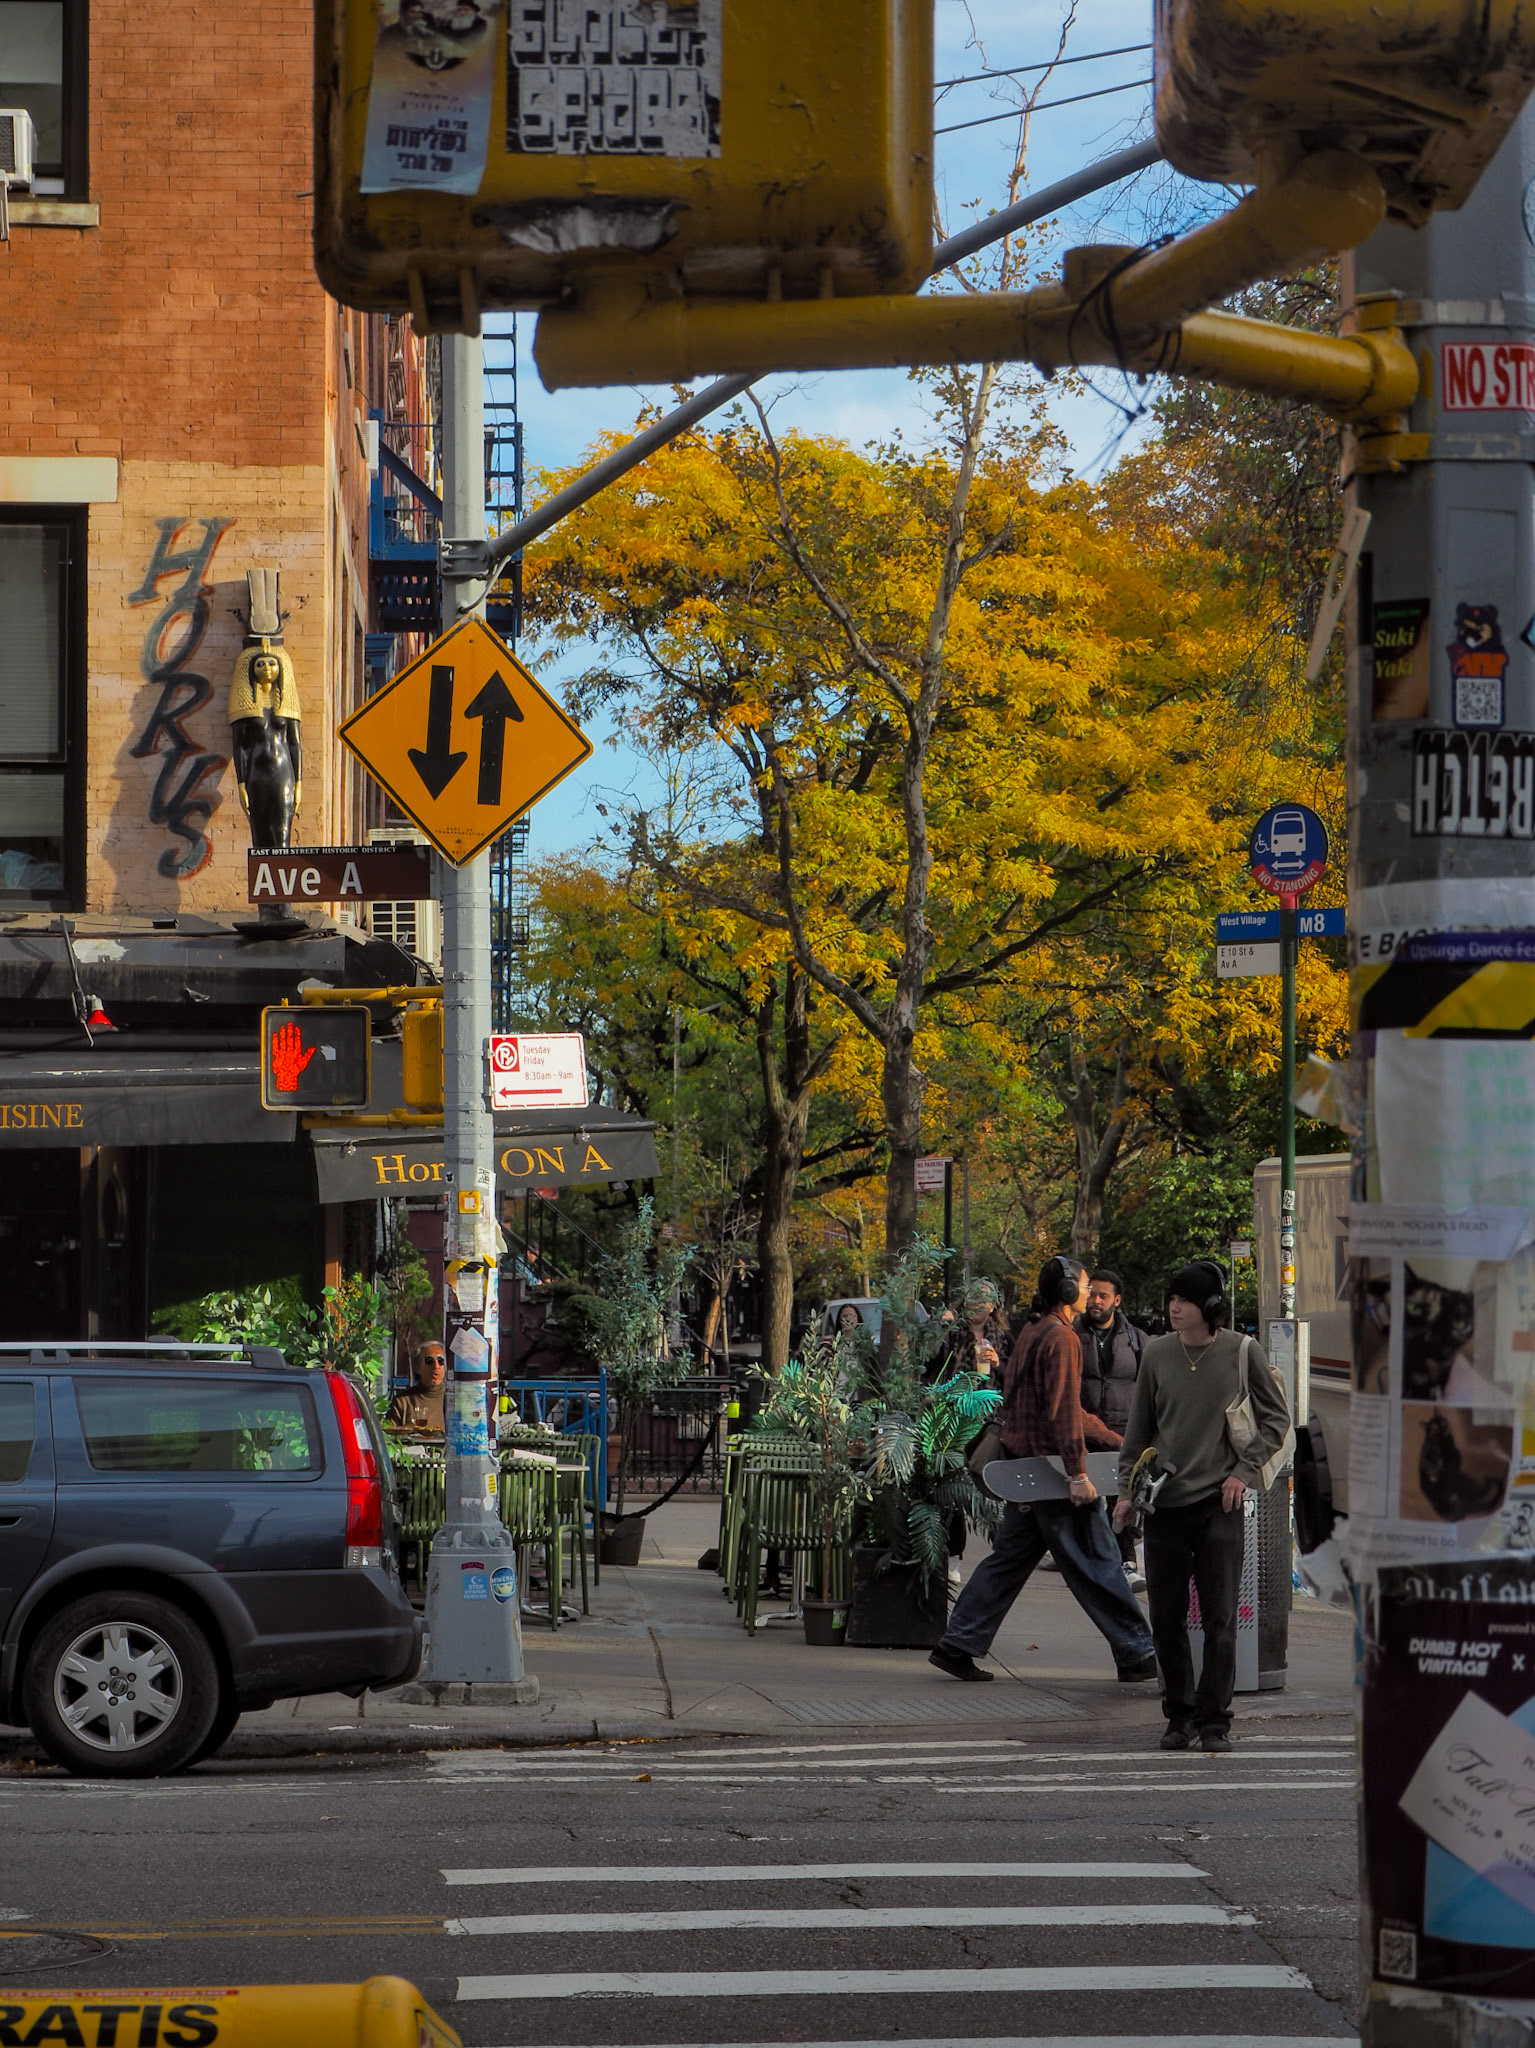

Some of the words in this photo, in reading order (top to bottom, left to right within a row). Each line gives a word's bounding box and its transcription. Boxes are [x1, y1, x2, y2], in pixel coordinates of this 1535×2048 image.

[1449, 346, 1487, 406] NO
[1374, 627, 1415, 648] Suki
[1375, 657, 1415, 678] Yaki
[127, 516, 237, 880] HORUS
[253, 862, 321, 896] Ave
[340, 861, 363, 895] A
[1258, 870, 1271, 886] NO
[1273, 868, 1319, 892] STANDING
[1220, 918, 1239, 927] West
[1241, 915, 1266, 927] Village
[1300, 913, 1325, 933] M8
[1221, 948, 1226, 957] E
[1228, 947, 1237, 957] 10
[1239, 947, 1246, 956] St
[1248, 947, 1254, 956] &
[1410, 941, 1465, 961] Upsurge
[1469, 940, 1512, 958] Dance
[1220, 961, 1229, 969] Av
[1231, 960, 1237, 968] A
[523, 1046, 550, 1055] Tuesday
[524, 1057, 545, 1065] Friday
[525, 1072, 551, 1080] 8:30am
[558, 1071, 573, 1079] 9am
[501, 1146, 566, 1177] ON
[581, 1144, 613, 1173] A
[1408, 1637, 1457, 1656] DUMB
[1460, 1641, 1502, 1659] HOT
[1418, 1657, 1489, 1678] VINTAGE
